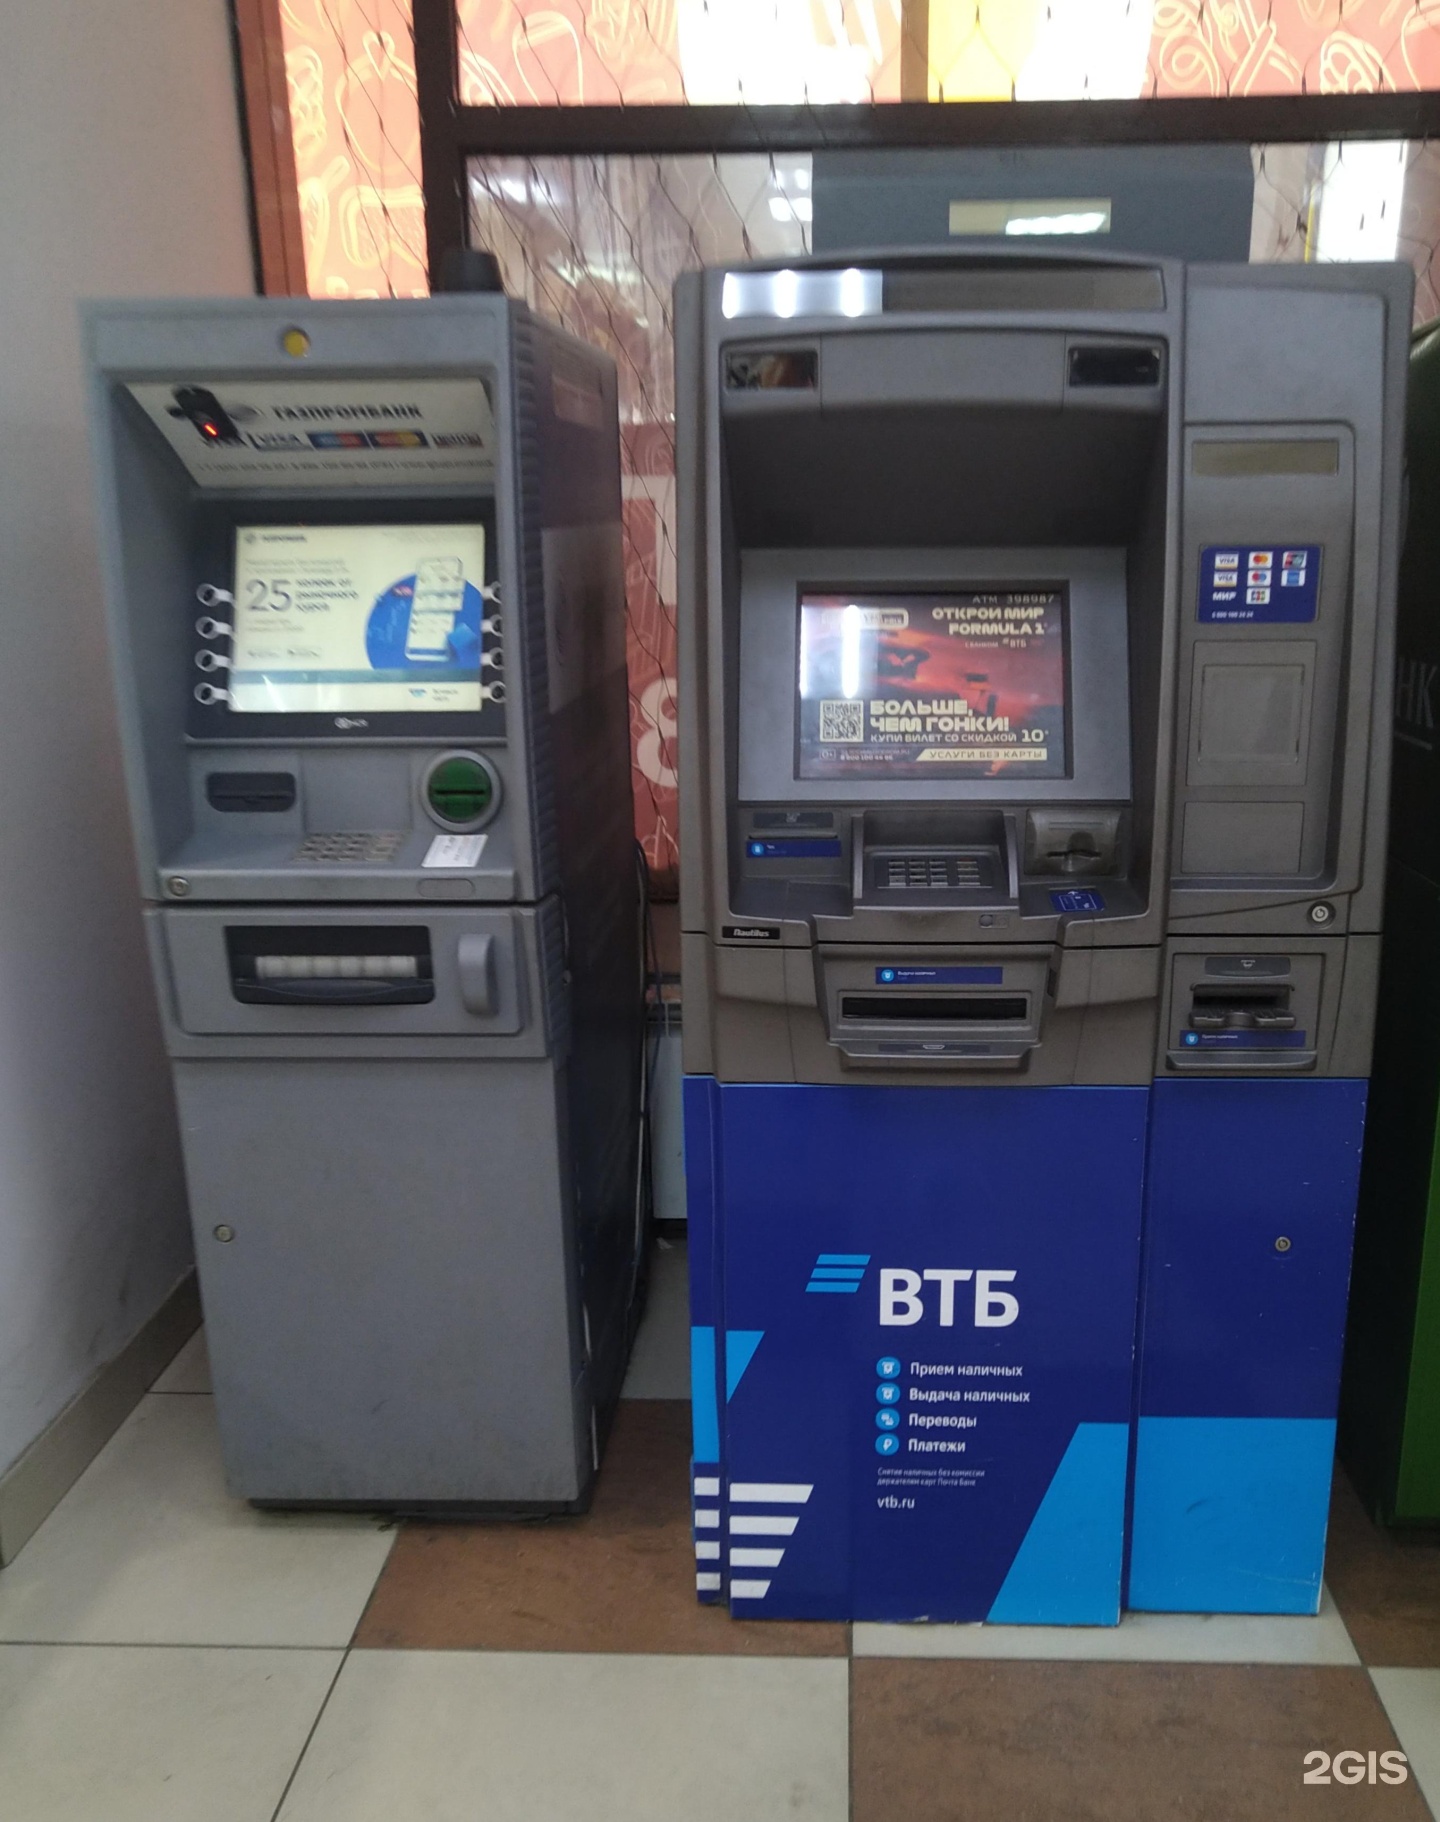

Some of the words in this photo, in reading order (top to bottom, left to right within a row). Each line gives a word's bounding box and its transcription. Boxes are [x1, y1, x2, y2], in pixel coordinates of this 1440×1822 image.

[245, 579, 292, 612] 25
[972, 594, 998, 604] ATM
[1212, 591, 1237, 601] МИР
[1004, 606, 1045, 621] МИР
[948, 621, 1033, 636] FORMULA
[869, 699, 973, 717] БОЛЬШЕ,
[869, 716, 923, 733] ЧЕМ
[925, 716, 1010, 733] ГОНКИ!
[870, 733, 903, 744] КУПИ
[904, 733, 943, 743] БИЛЕТ
[944, 733, 959, 743] СО
[929, 750, 975, 759] УСЛУГИ
[979, 750, 1000, 759] БЕЗ
[1003, 750, 1043, 759] КАРТЫ
[879, 1268, 1020, 1328] ВТБ
[910, 1361, 954, 1378] Прием
[957, 1364, 1024, 1377] наличных
[909, 1387, 961, 1403] Выдача
[964, 1390, 1031, 1403] наличных
[908, 1412, 977, 1429] Переводы
[908, 1438, 966, 1452] Платежи
[877, 1467, 903, 1477] Снятие
[951, 1469, 986, 1478] комиссии
[920, 1478, 936, 1488] карт
[937, 1477, 958, 1487] Почта
[958, 1477, 976, 1487] Банк
[876, 1494, 915, 1509] vtb.ru
